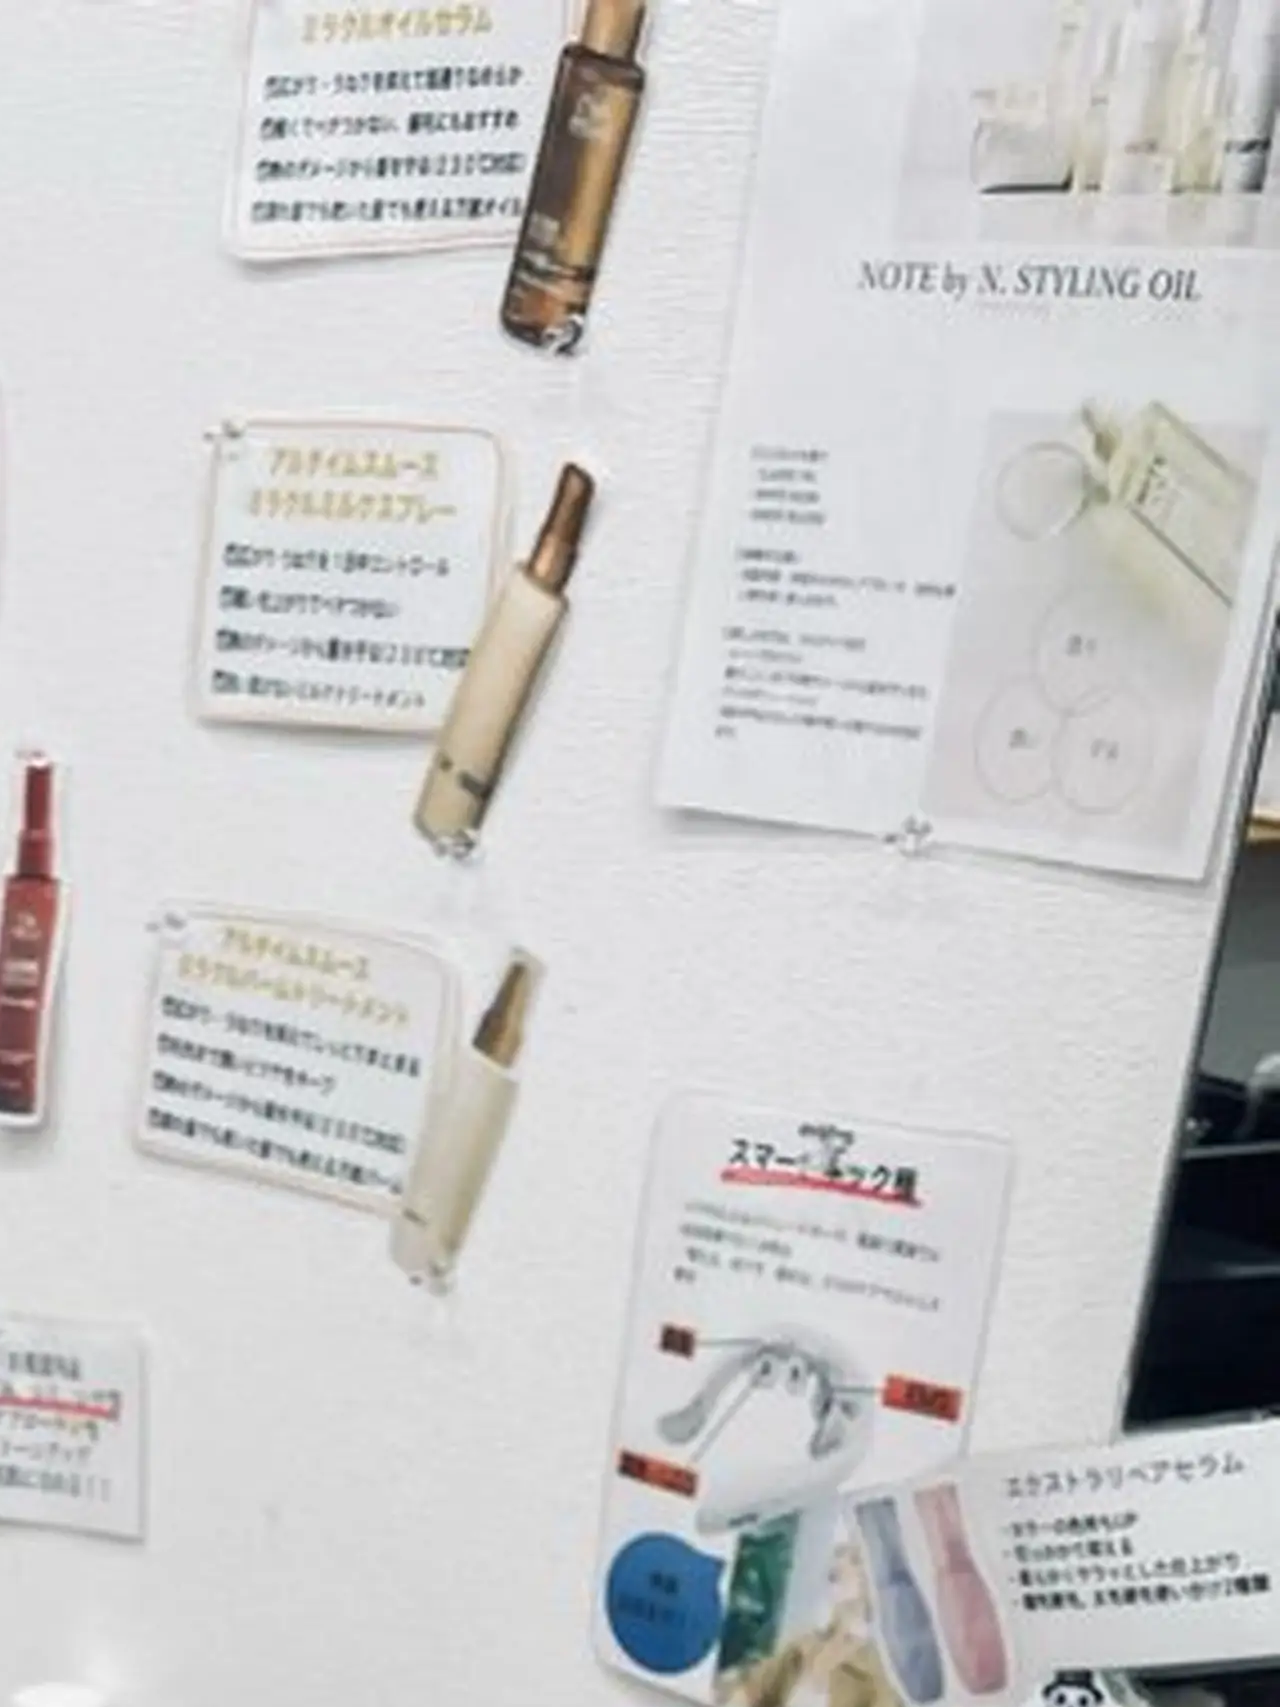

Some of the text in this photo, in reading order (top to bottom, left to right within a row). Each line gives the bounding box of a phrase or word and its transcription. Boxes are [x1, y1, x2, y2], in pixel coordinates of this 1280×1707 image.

[857, 260, 1203, 301] NOTE by N. STYLING OIL
[1004, 1451, 1246, 1498] エクストラリペアセラム
